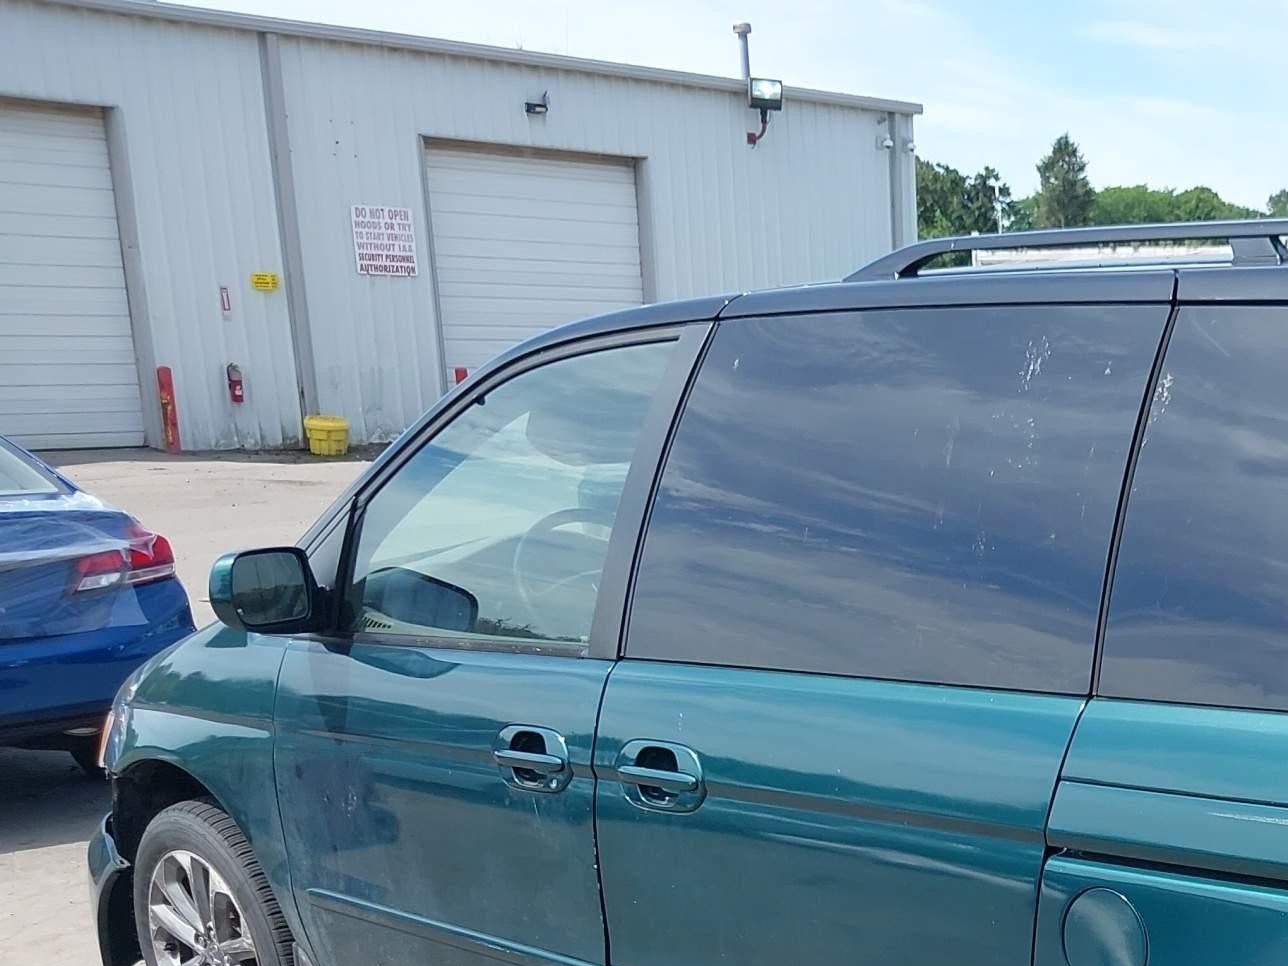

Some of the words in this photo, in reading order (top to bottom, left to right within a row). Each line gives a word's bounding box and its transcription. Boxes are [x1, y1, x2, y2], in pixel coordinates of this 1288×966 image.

[354, 207, 367, 219] DO
[369, 208, 385, 221] NOT
[387, 208, 409, 222] OPEN
[384, 222, 396, 231] OR
[397, 222, 411, 232] TRY
[354, 231, 364, 241] TO
[365, 232, 385, 242] START
[386, 232, 414, 243] VEHICLES
[357, 241, 396, 253] WITHOUT
[398, 244, 413, 254] IAA
[358, 252, 384, 262] SECURITY
[385, 254, 415, 264] PERSONNEL
[360, 263, 416, 275] AUTHORIZATION
